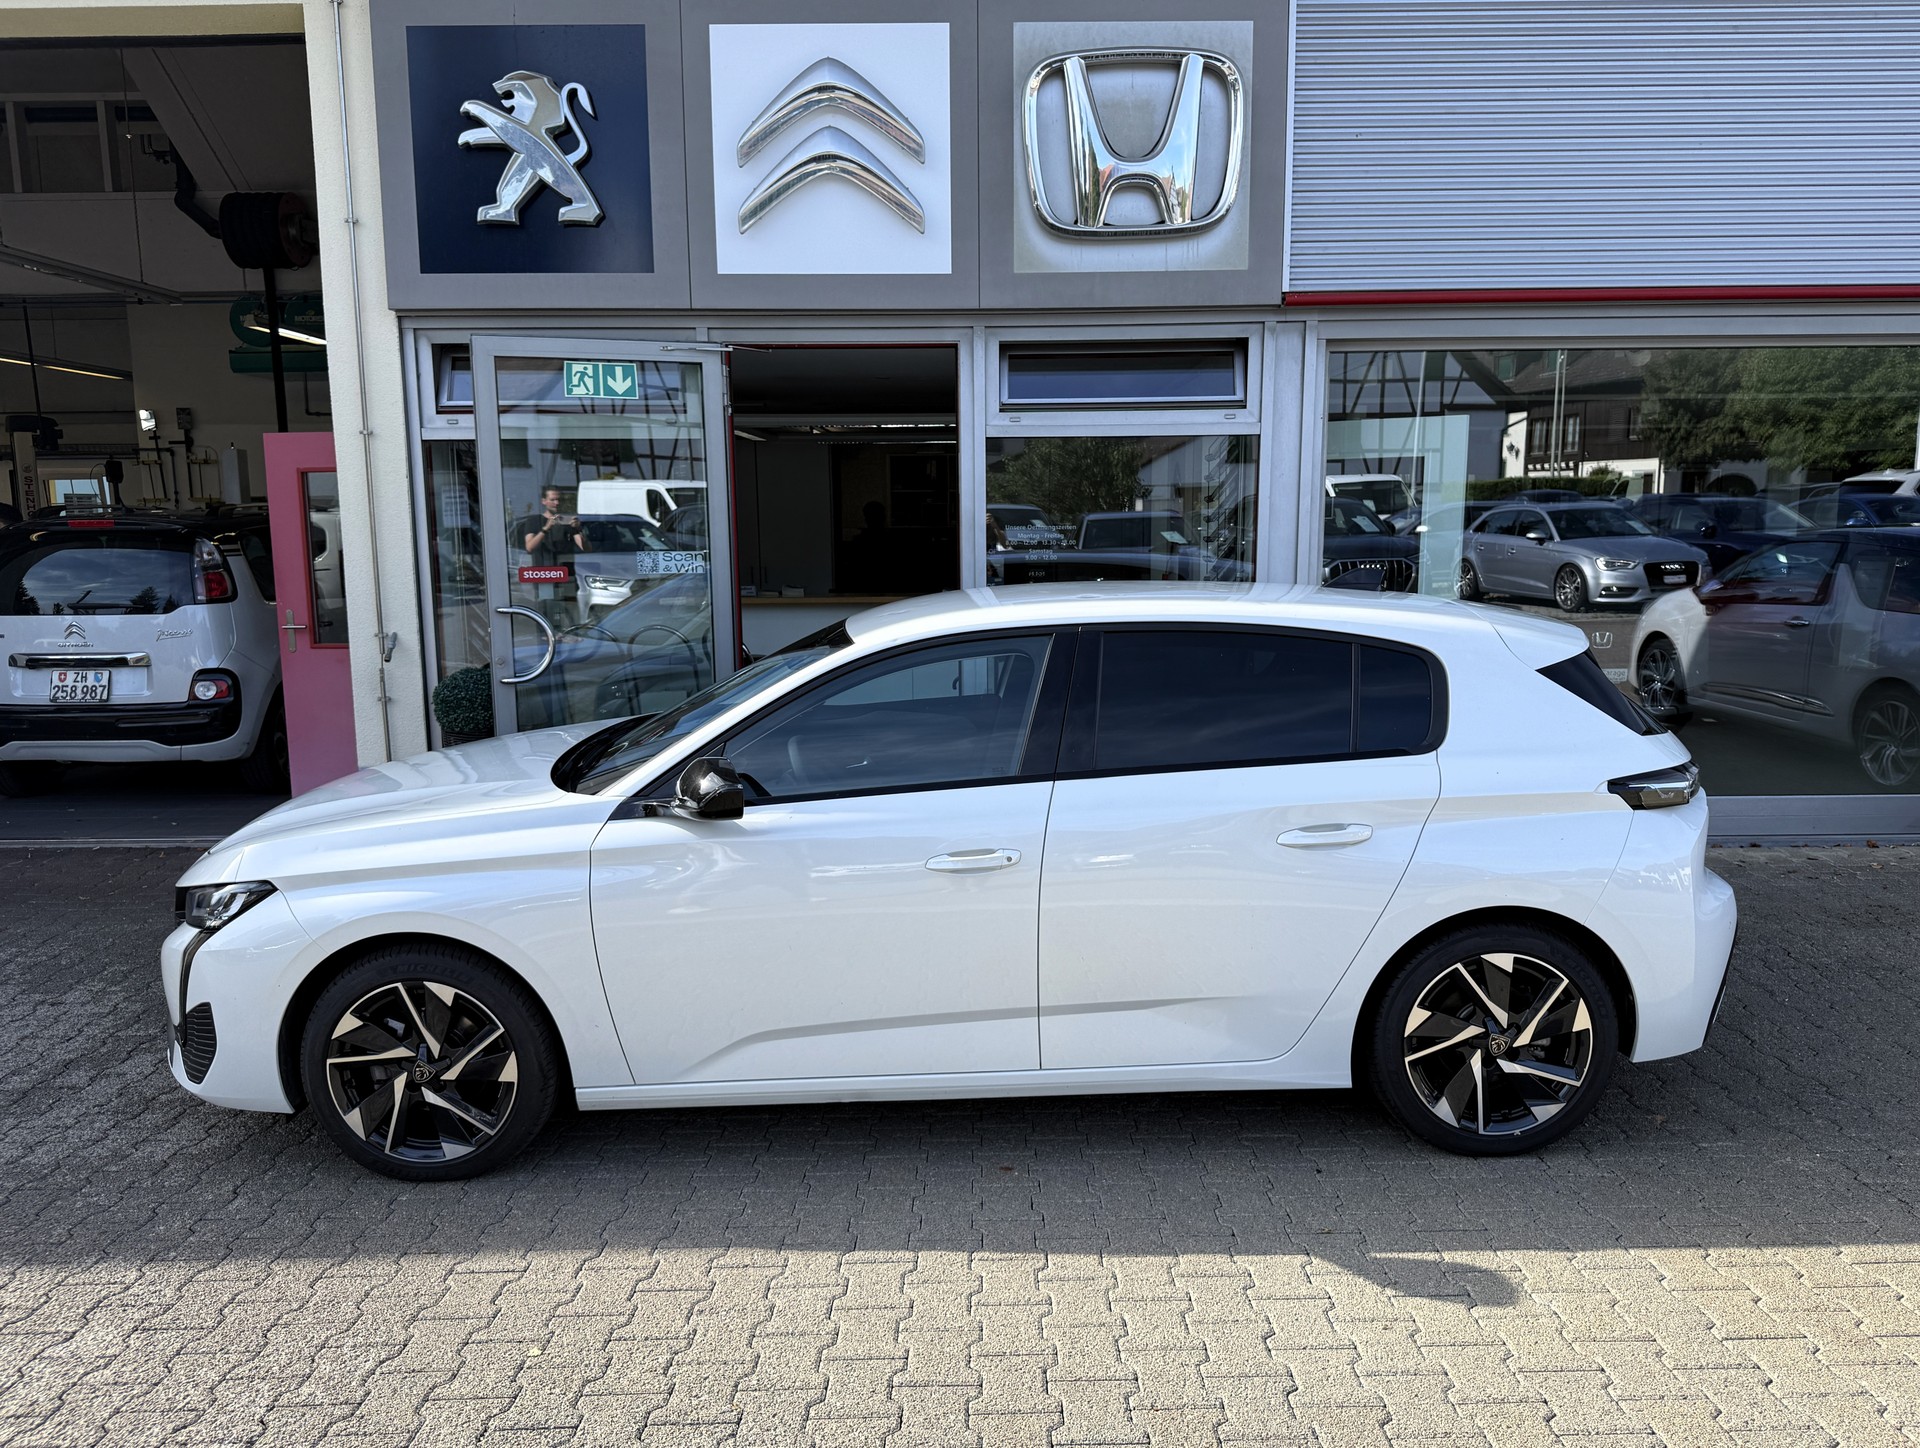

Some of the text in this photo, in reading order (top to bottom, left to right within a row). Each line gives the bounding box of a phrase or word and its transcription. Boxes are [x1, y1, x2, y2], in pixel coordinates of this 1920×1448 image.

[662, 552, 705, 562] Scan
[662, 562, 705, 573] & Win
[523, 570, 564, 579] stossen
[73, 671, 87, 683] ZH
